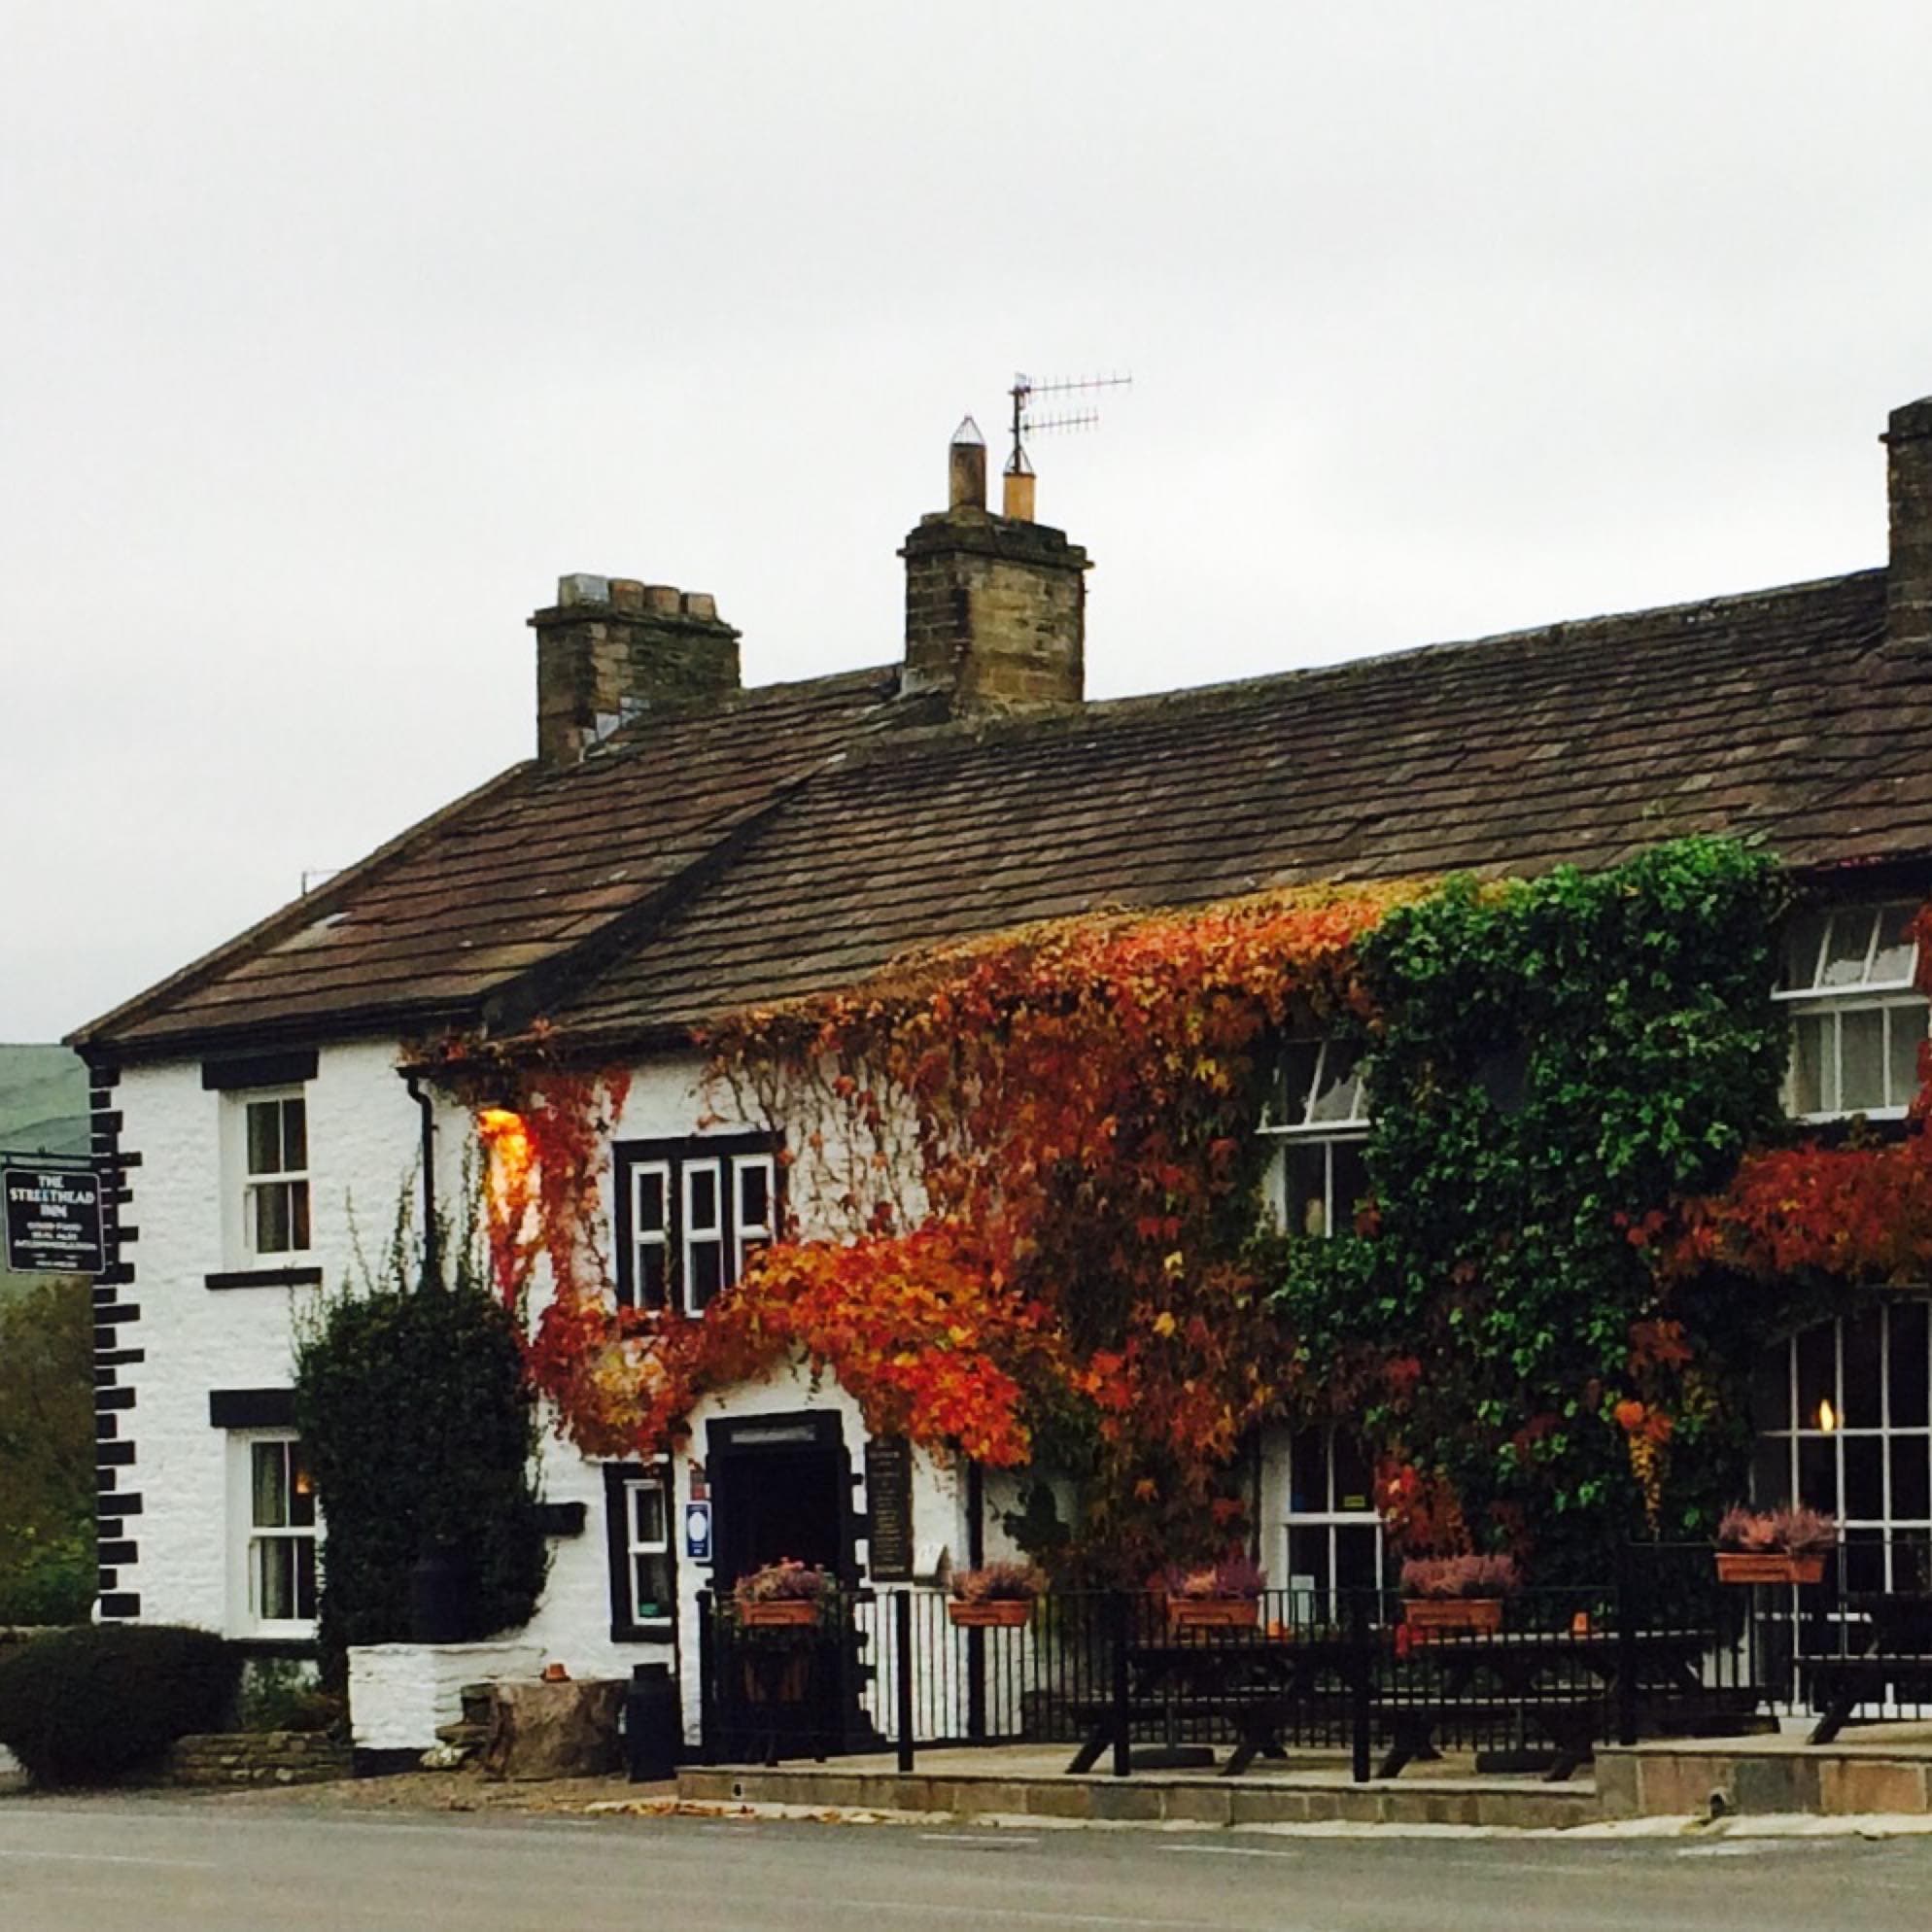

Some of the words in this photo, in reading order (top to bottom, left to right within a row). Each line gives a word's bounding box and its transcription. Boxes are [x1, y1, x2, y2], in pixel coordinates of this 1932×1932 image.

[38, 1175, 64, 1189] THE
[10, 1188, 95, 1204] STREETHEAD
[40, 1205, 68, 1218] INN
